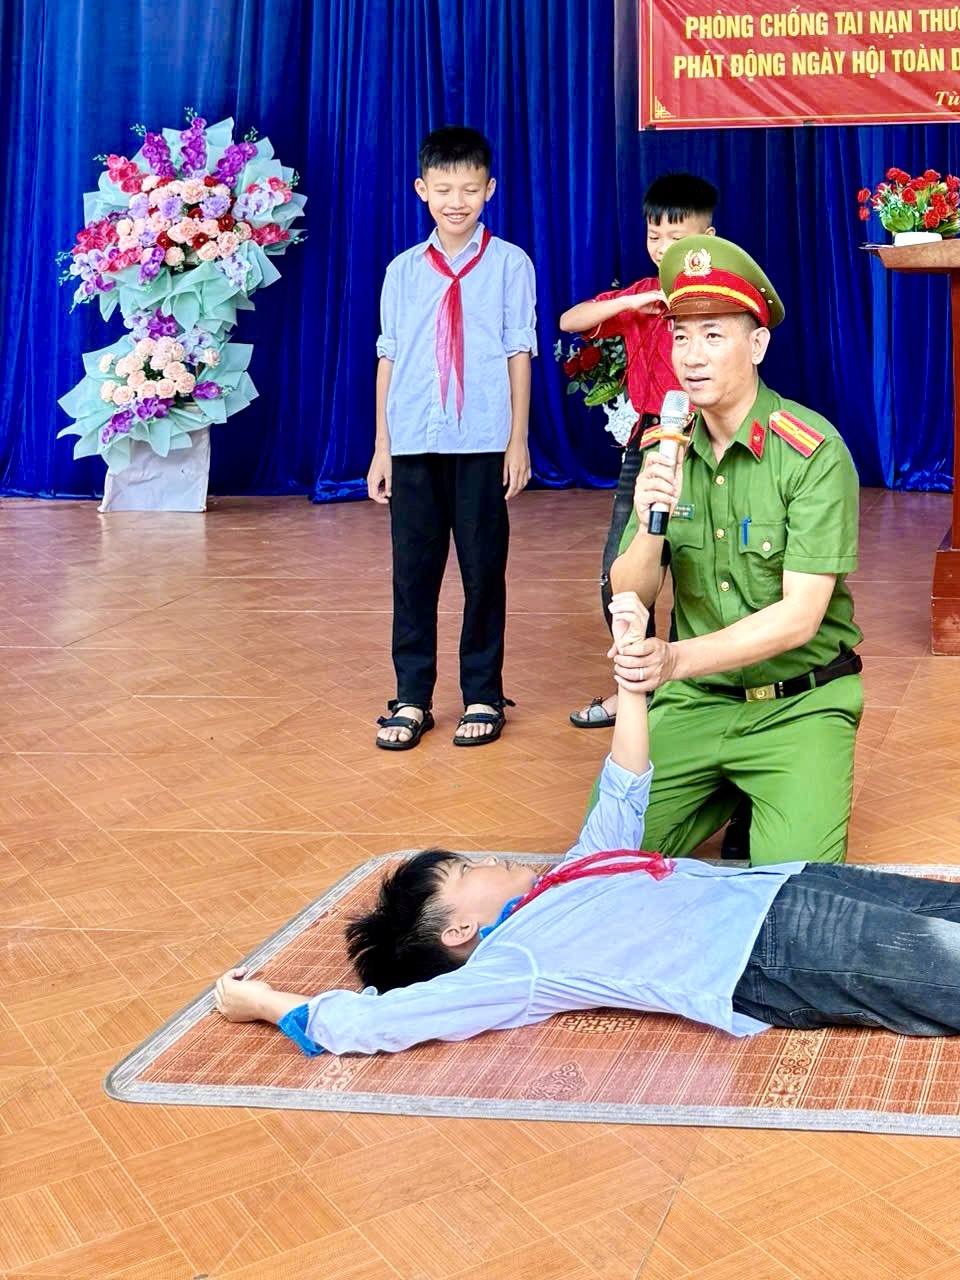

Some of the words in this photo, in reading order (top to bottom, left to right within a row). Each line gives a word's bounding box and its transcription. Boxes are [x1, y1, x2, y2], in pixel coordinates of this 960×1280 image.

[686, 10, 753, 39] PHÒNG
[760, 5, 828, 37] CHỐNG
[835, 11, 863, 35] TAI
[870, 9, 912, 38] NẠN
[674, 50, 724, 79] PHÁT
[730, 49, 785, 82] ĐỘNG
[792, 47, 846, 75] NGÀY
[852, 46, 885, 78] HỘI
[891, 43, 944, 73] TOÀN
